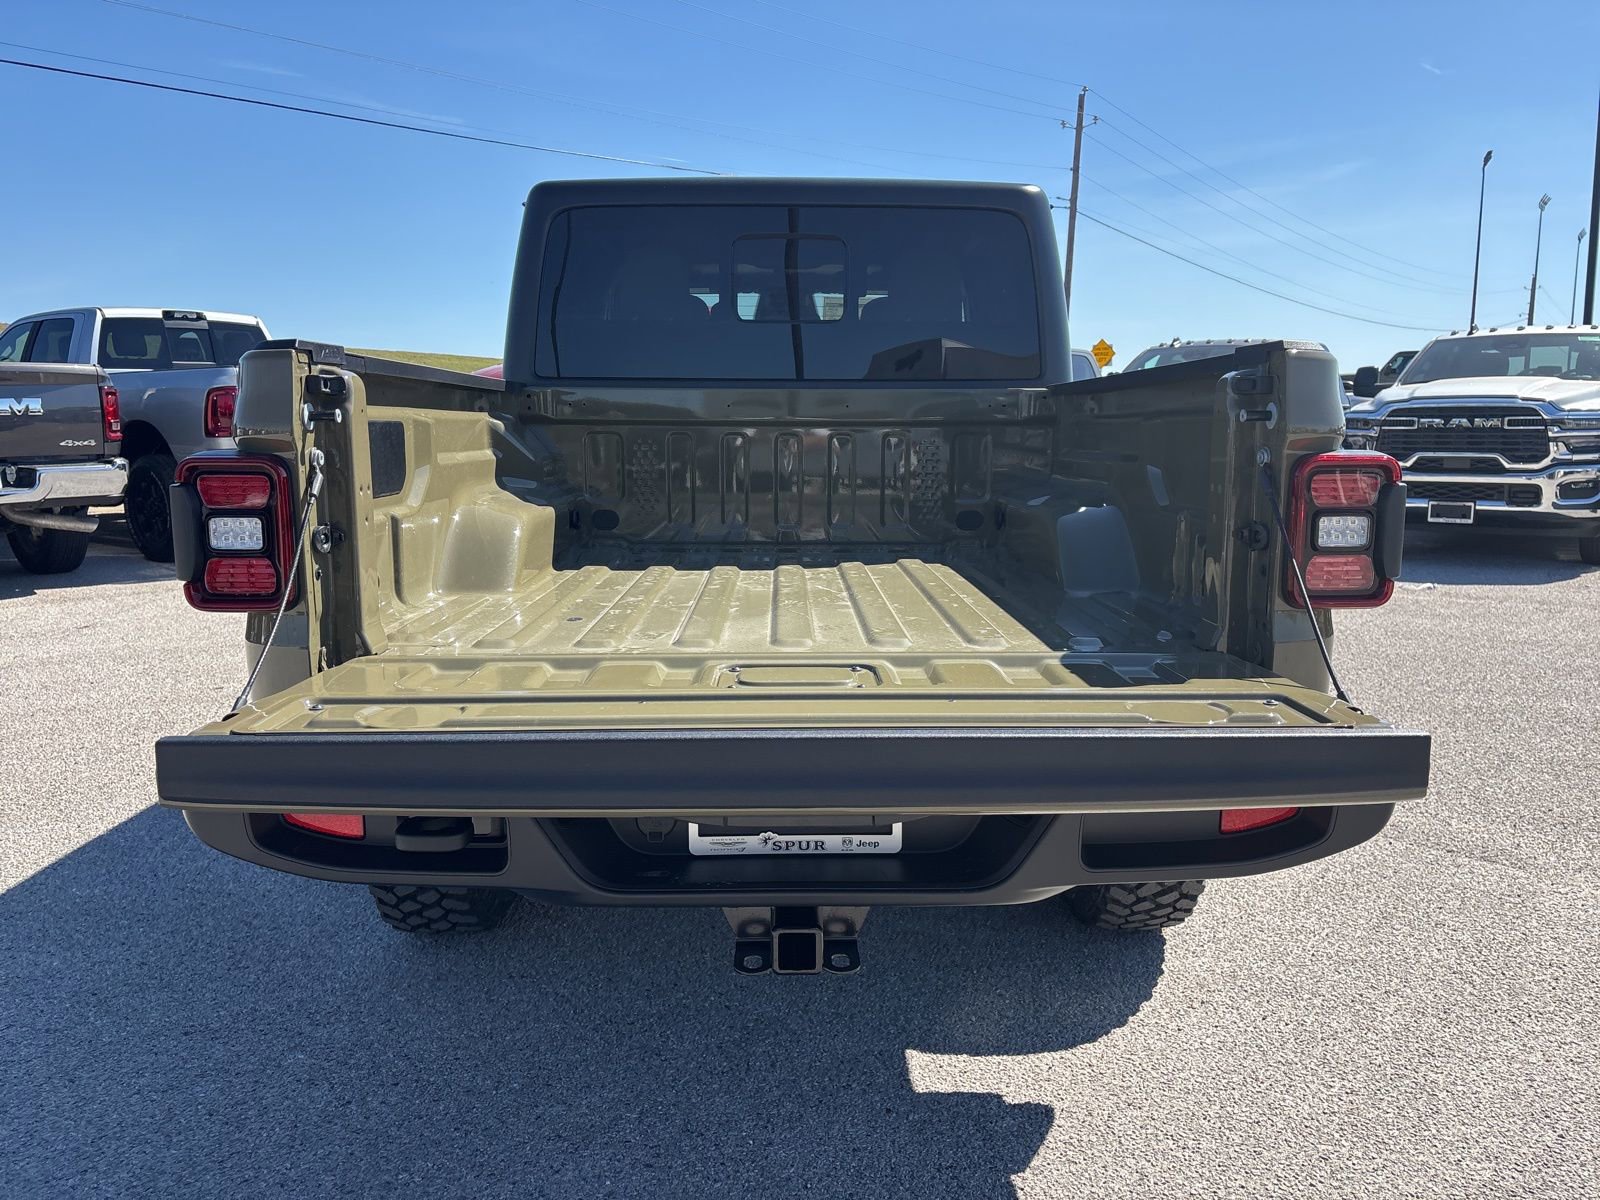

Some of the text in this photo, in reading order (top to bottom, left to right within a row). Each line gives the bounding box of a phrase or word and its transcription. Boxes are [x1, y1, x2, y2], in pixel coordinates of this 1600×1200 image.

[1419, 418, 1501, 428] RAM
[60, 439, 97, 447] 4x4
[772, 840, 826, 851] SPUR
[856, 839, 880, 849] Jeep
